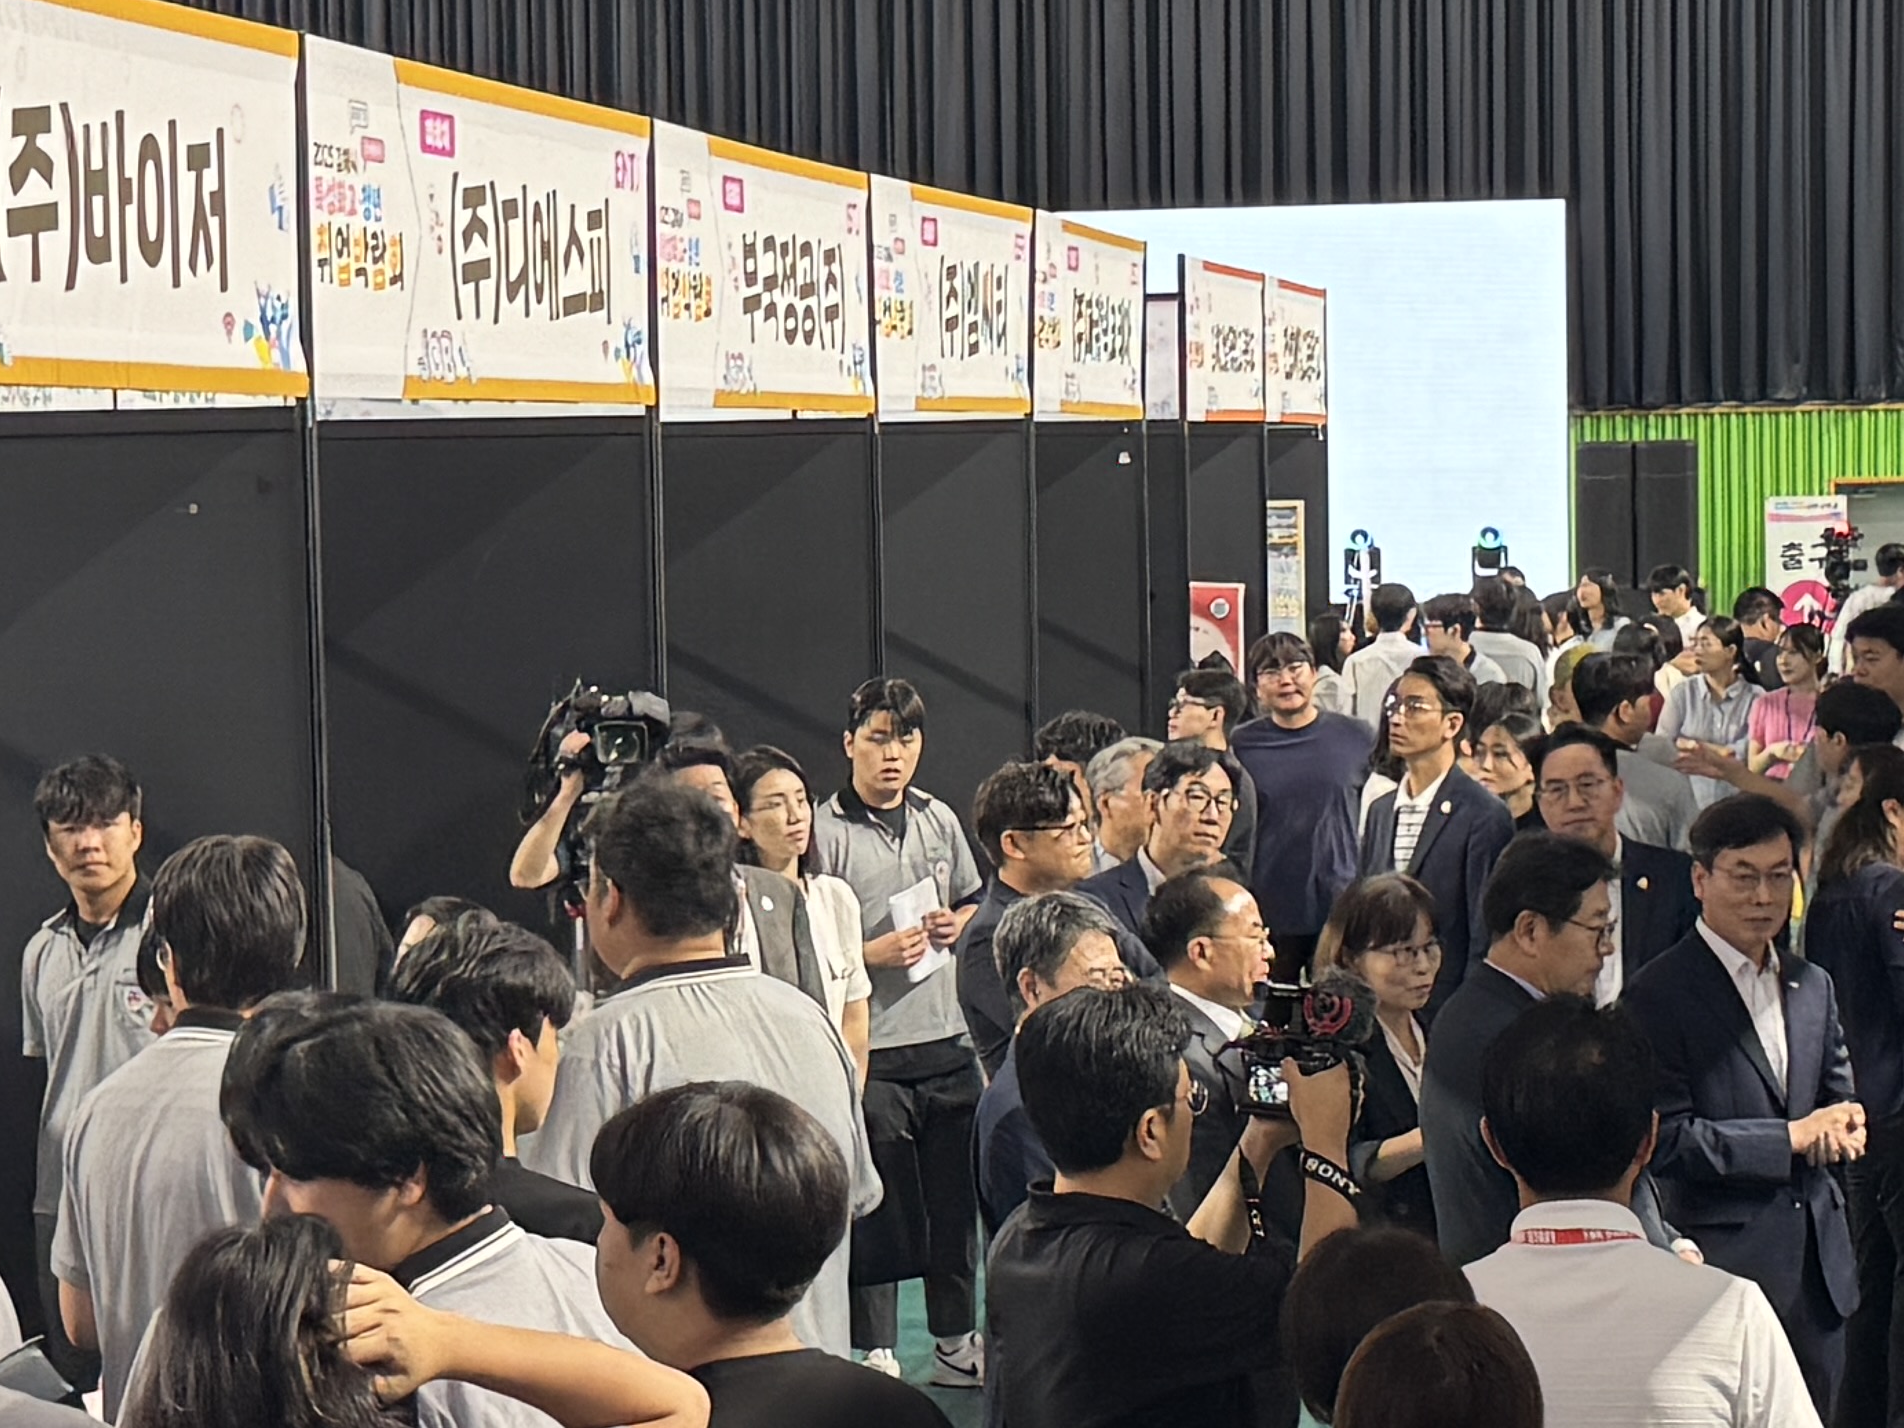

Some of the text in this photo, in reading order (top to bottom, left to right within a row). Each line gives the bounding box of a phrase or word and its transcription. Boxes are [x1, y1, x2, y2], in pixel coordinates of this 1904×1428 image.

[451, 171, 612, 325] (주)디에스피
[742, 231, 846, 355] 부국정공(주)
[1304, 1155, 1362, 1196] SONY
